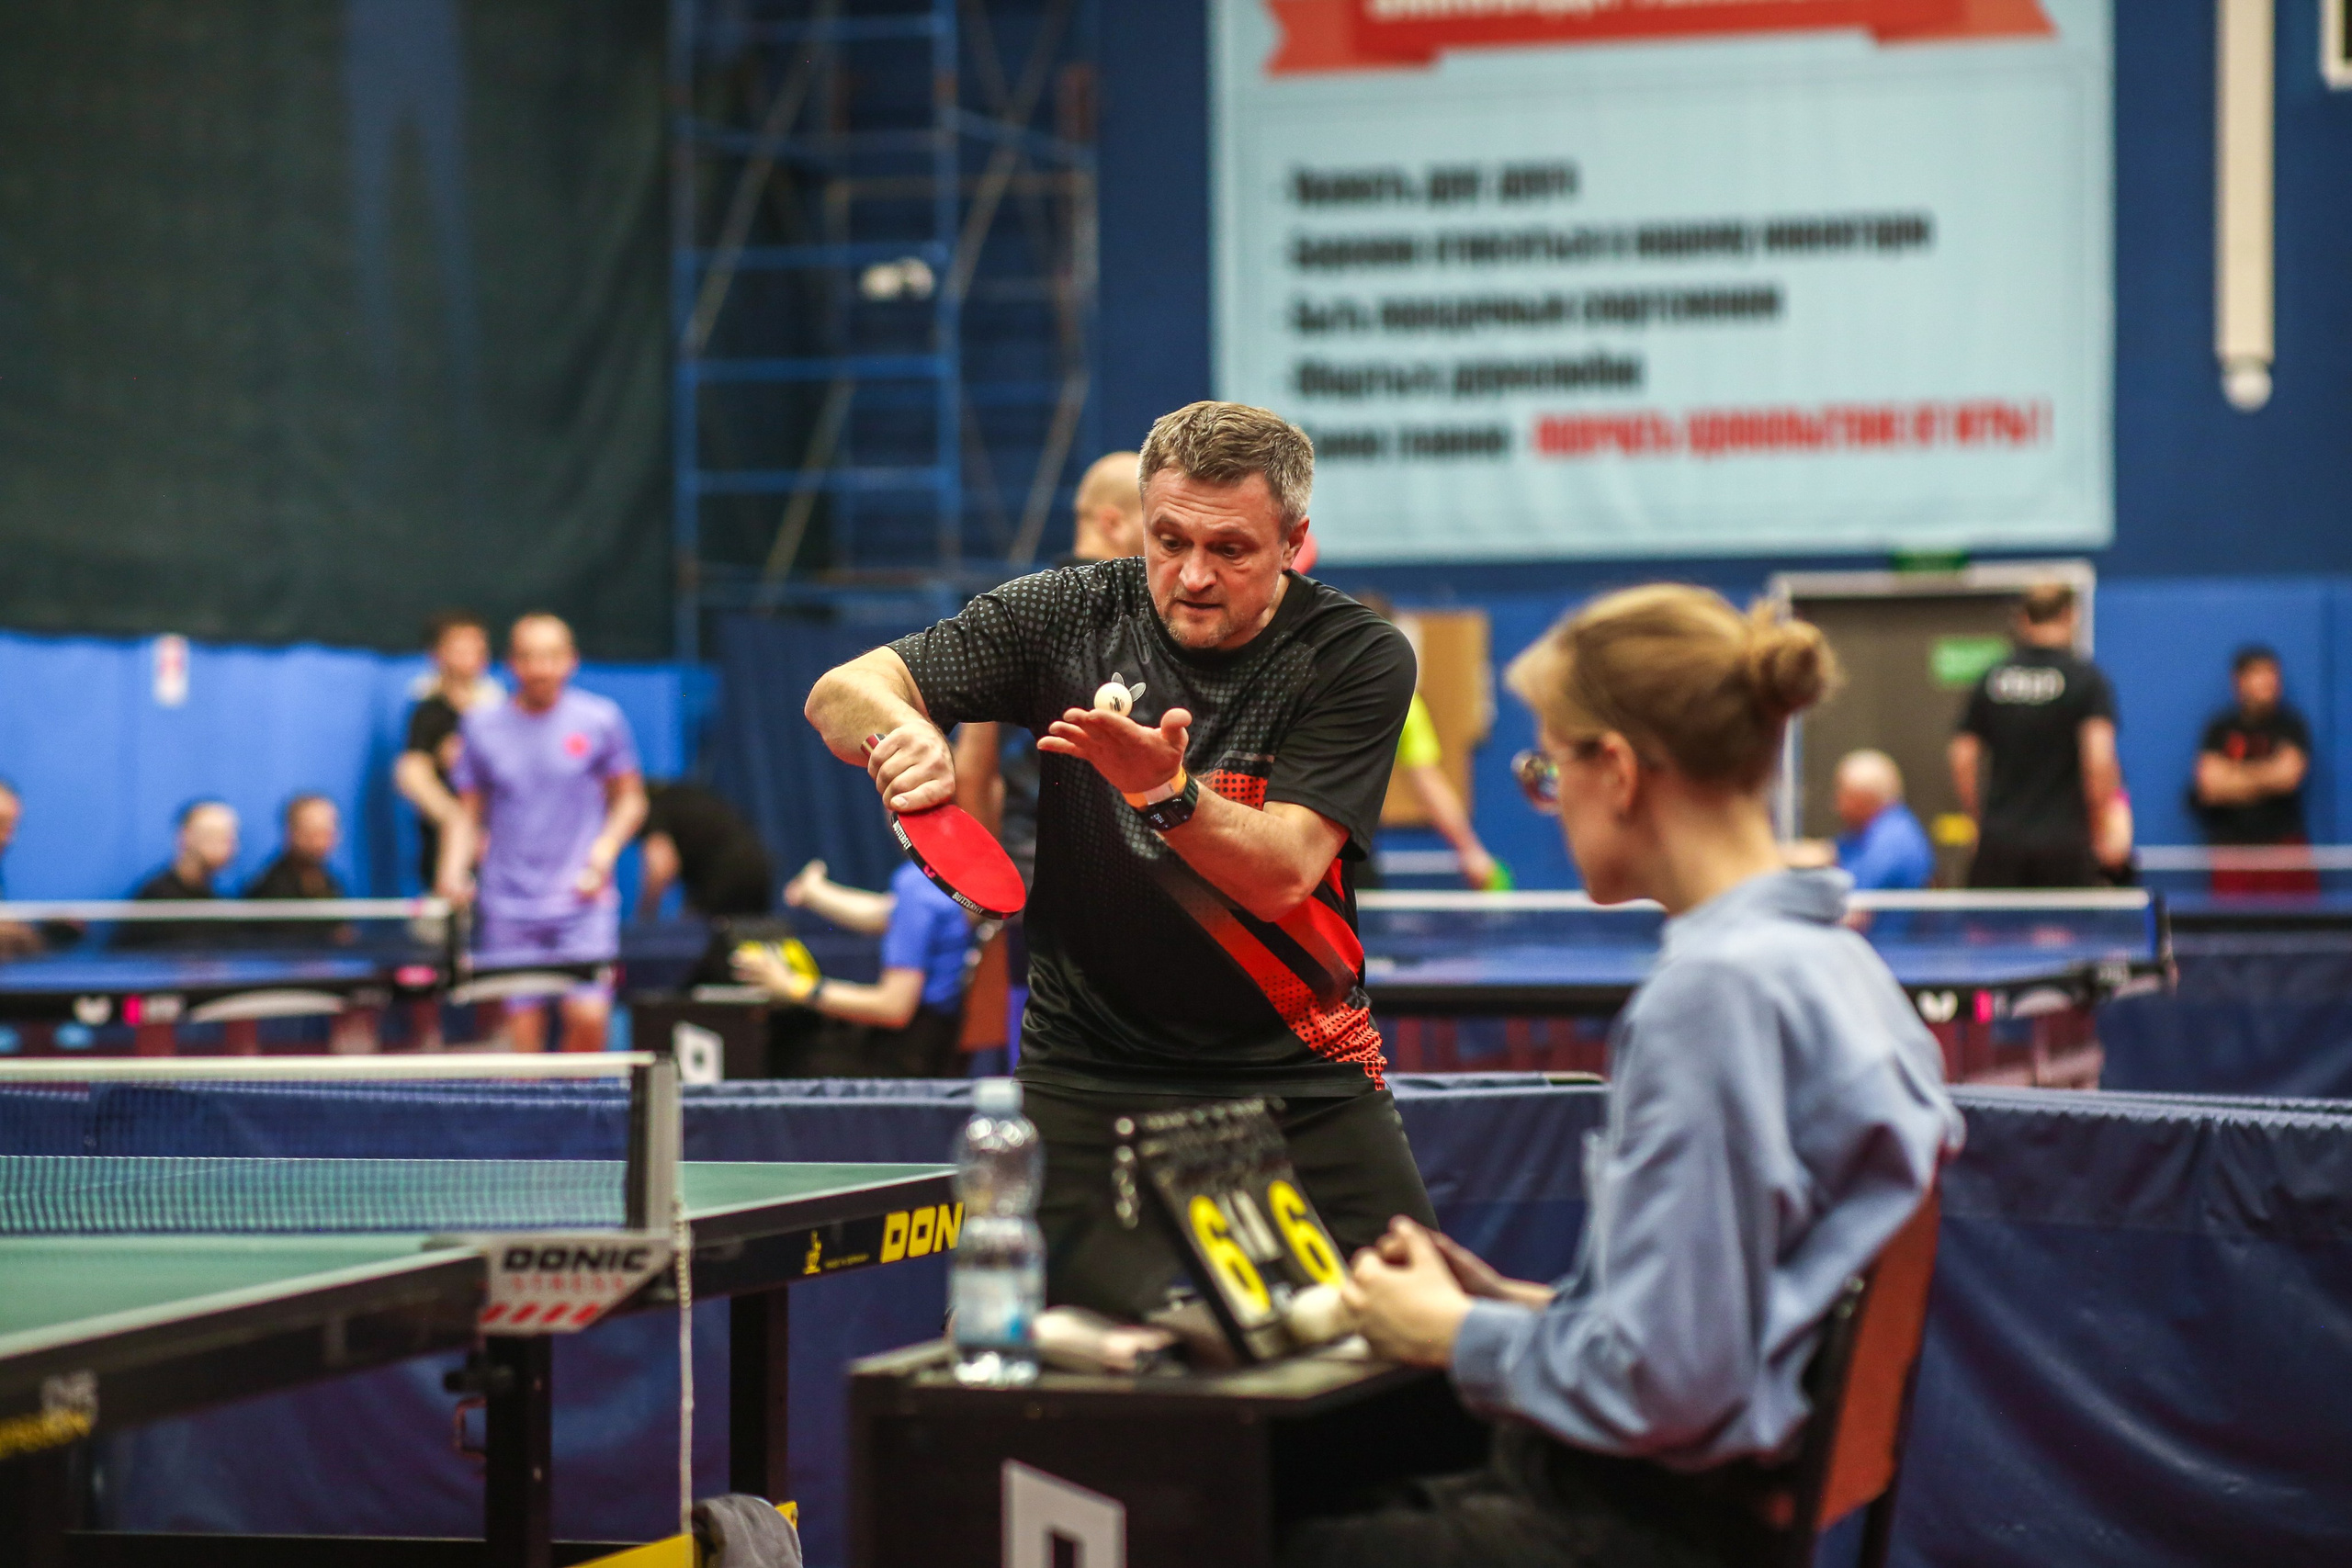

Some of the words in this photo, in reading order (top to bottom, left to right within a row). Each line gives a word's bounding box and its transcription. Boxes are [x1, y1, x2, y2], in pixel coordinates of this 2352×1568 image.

[892, 819, 912, 851] BUTTERFLY
[952, 891, 985, 914] BUTTERFLY
[879, 1201, 965, 1264] DON
[1189, 1195, 1272, 1314] 6
[1268, 1179, 1346, 1288] 6
[503, 1246, 650, 1273] DONIC
